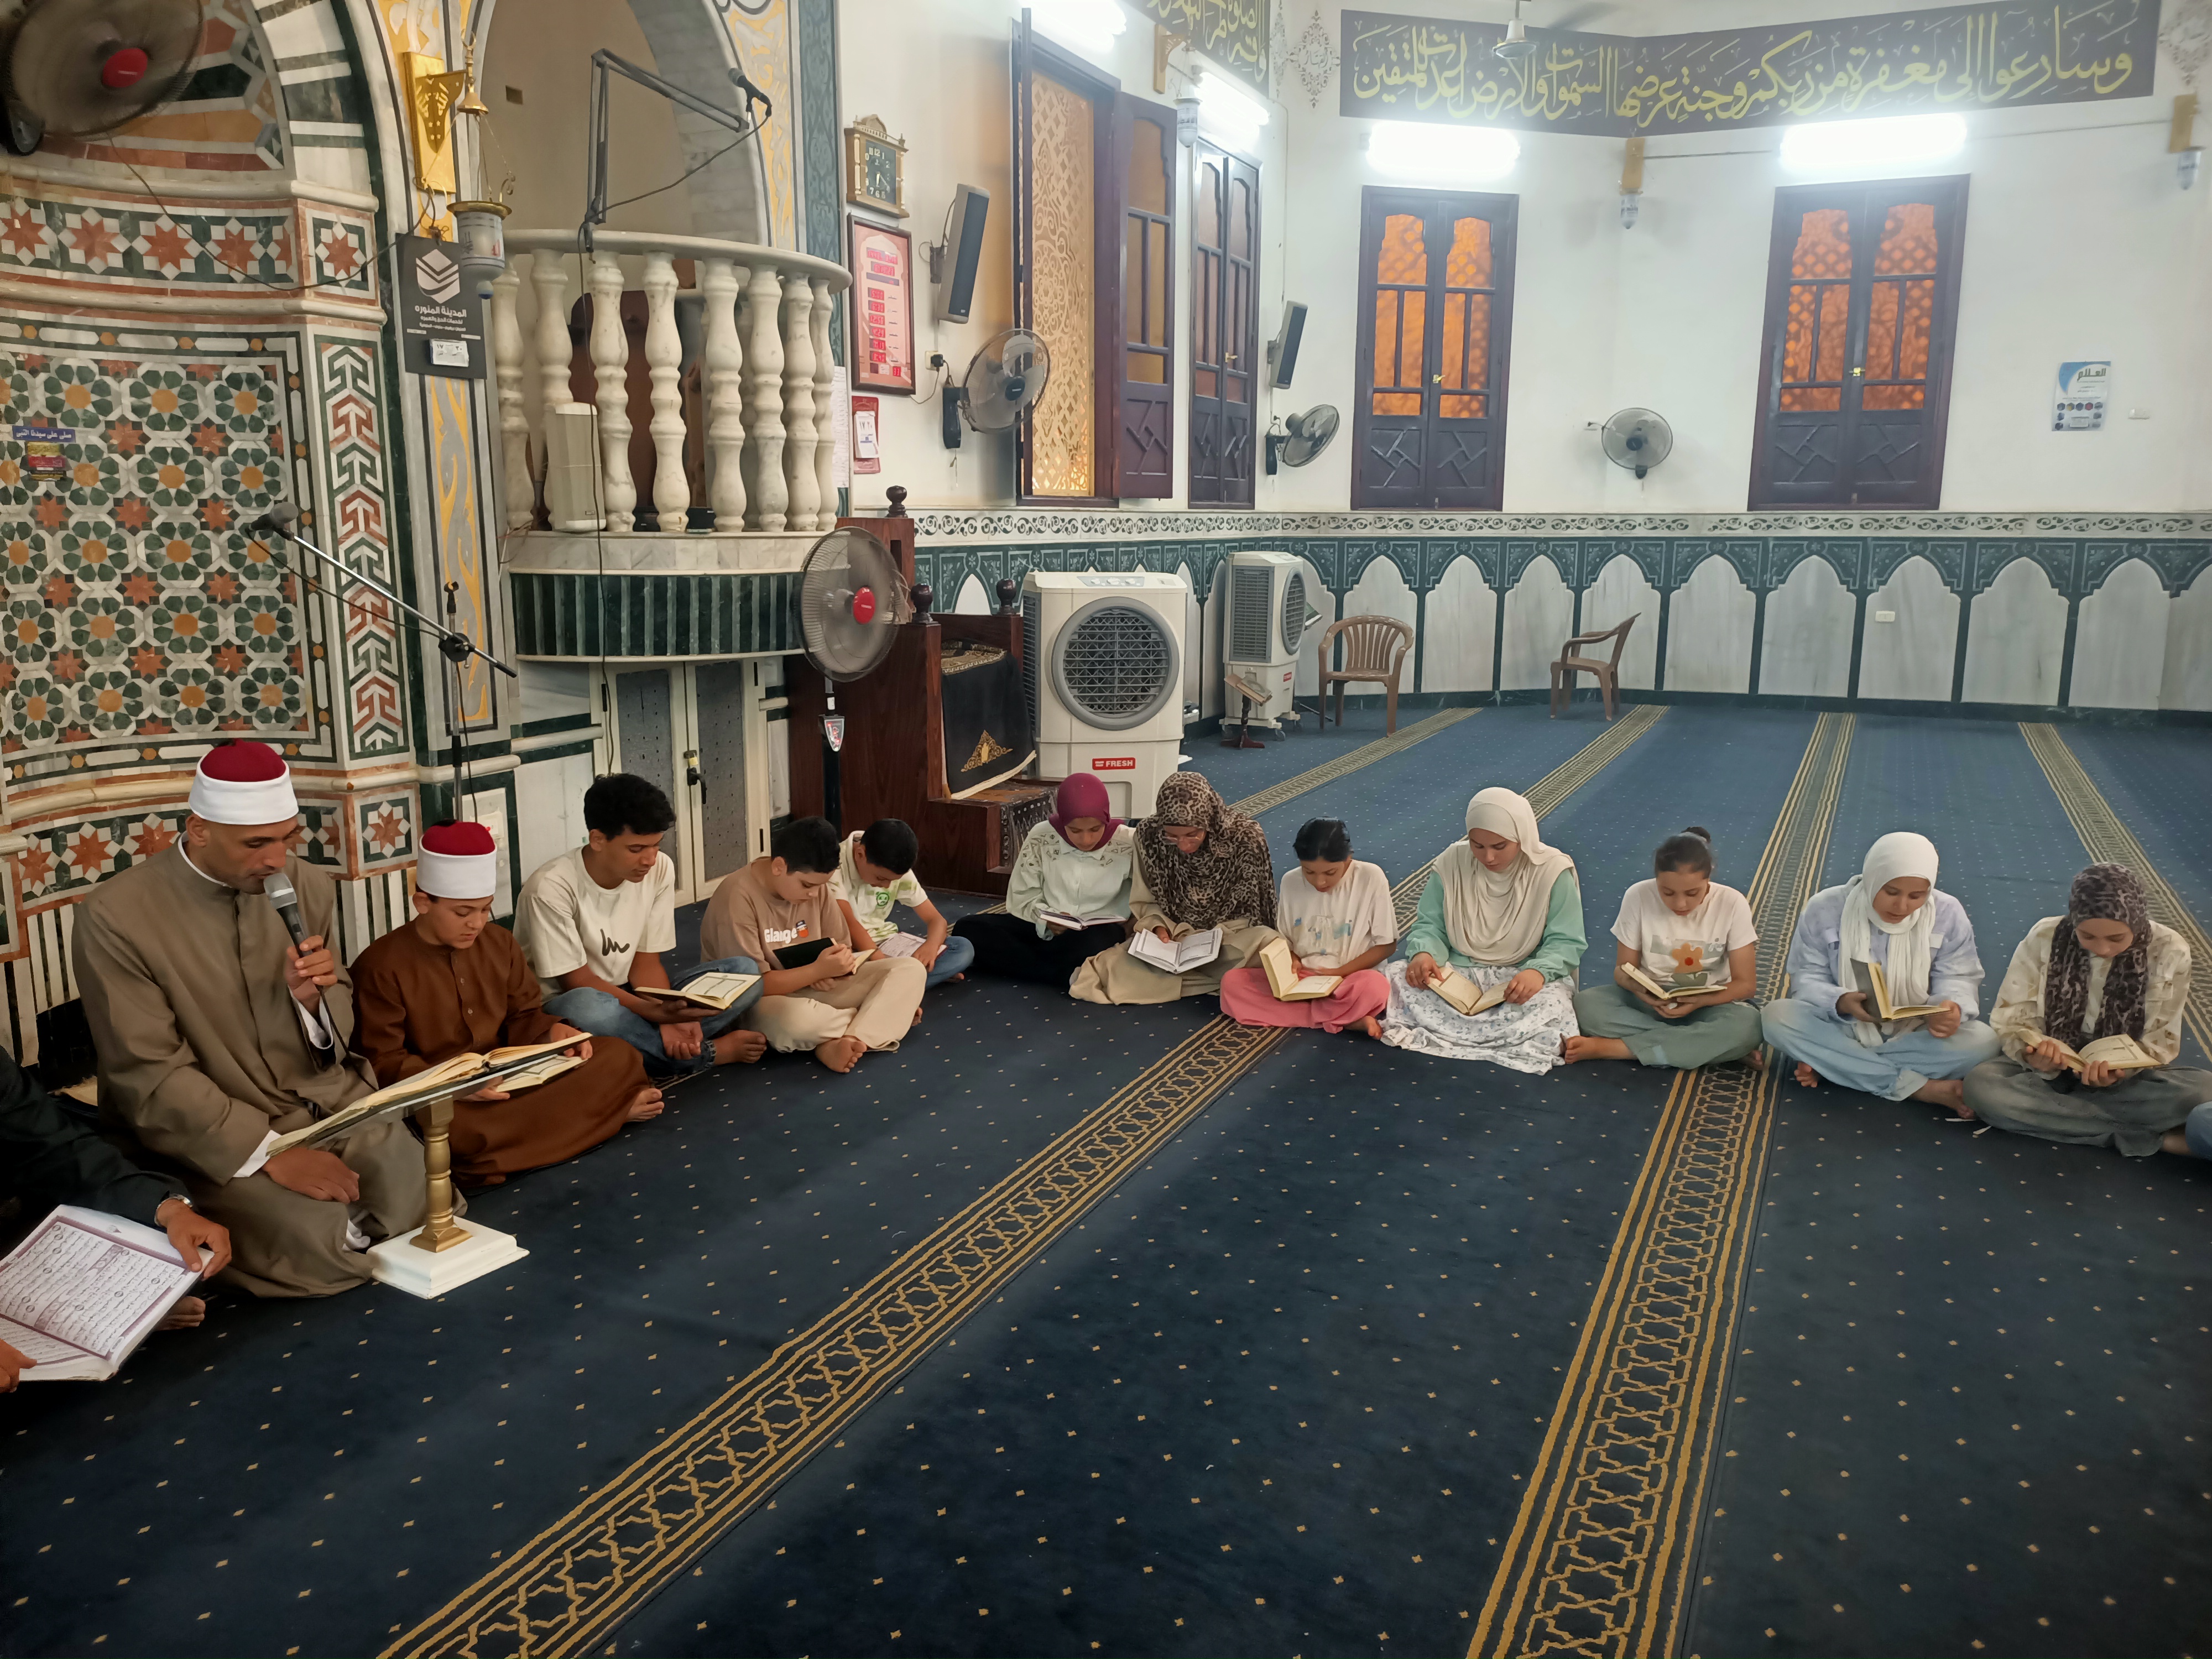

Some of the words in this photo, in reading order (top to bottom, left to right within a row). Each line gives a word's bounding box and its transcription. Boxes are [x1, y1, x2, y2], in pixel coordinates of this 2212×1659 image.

[874, 148, 880, 157] 12
[441, 305, 467, 318] المدينة
[1105, 759, 1134, 768] FRESH
